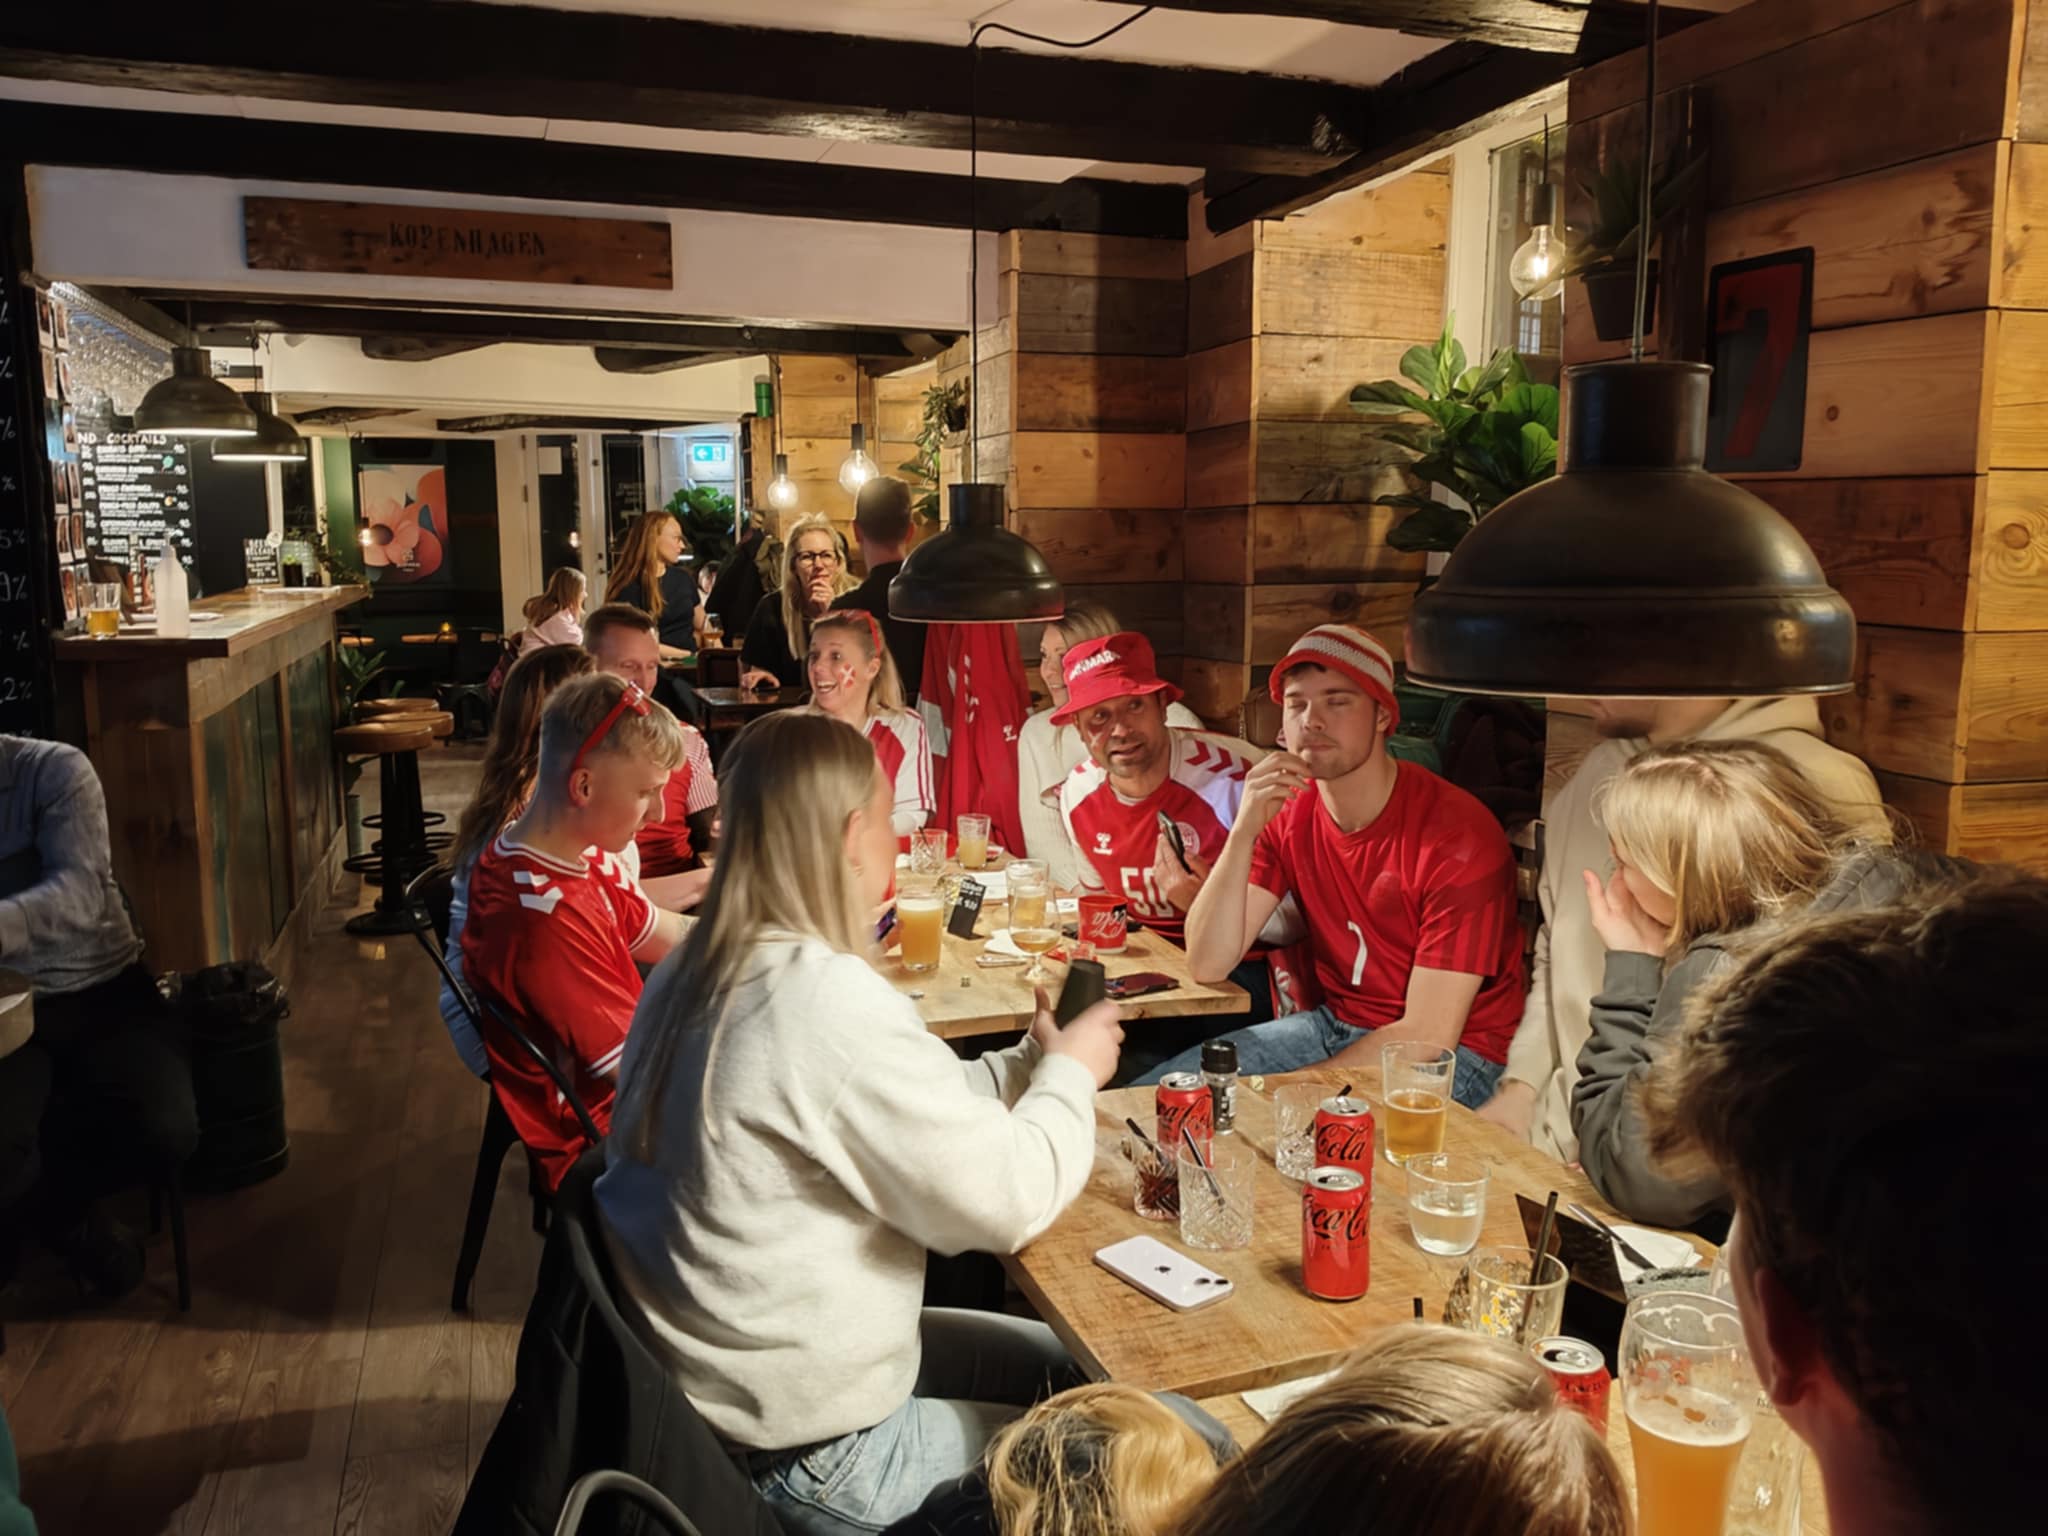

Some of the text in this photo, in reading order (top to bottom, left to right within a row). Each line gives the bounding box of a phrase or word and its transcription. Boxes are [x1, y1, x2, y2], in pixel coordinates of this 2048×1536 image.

[390, 223, 545, 256] KOPENHAGEN
[106, 432, 167, 445] COCKTAILS
[1316, 1122, 1369, 1161] Cola
